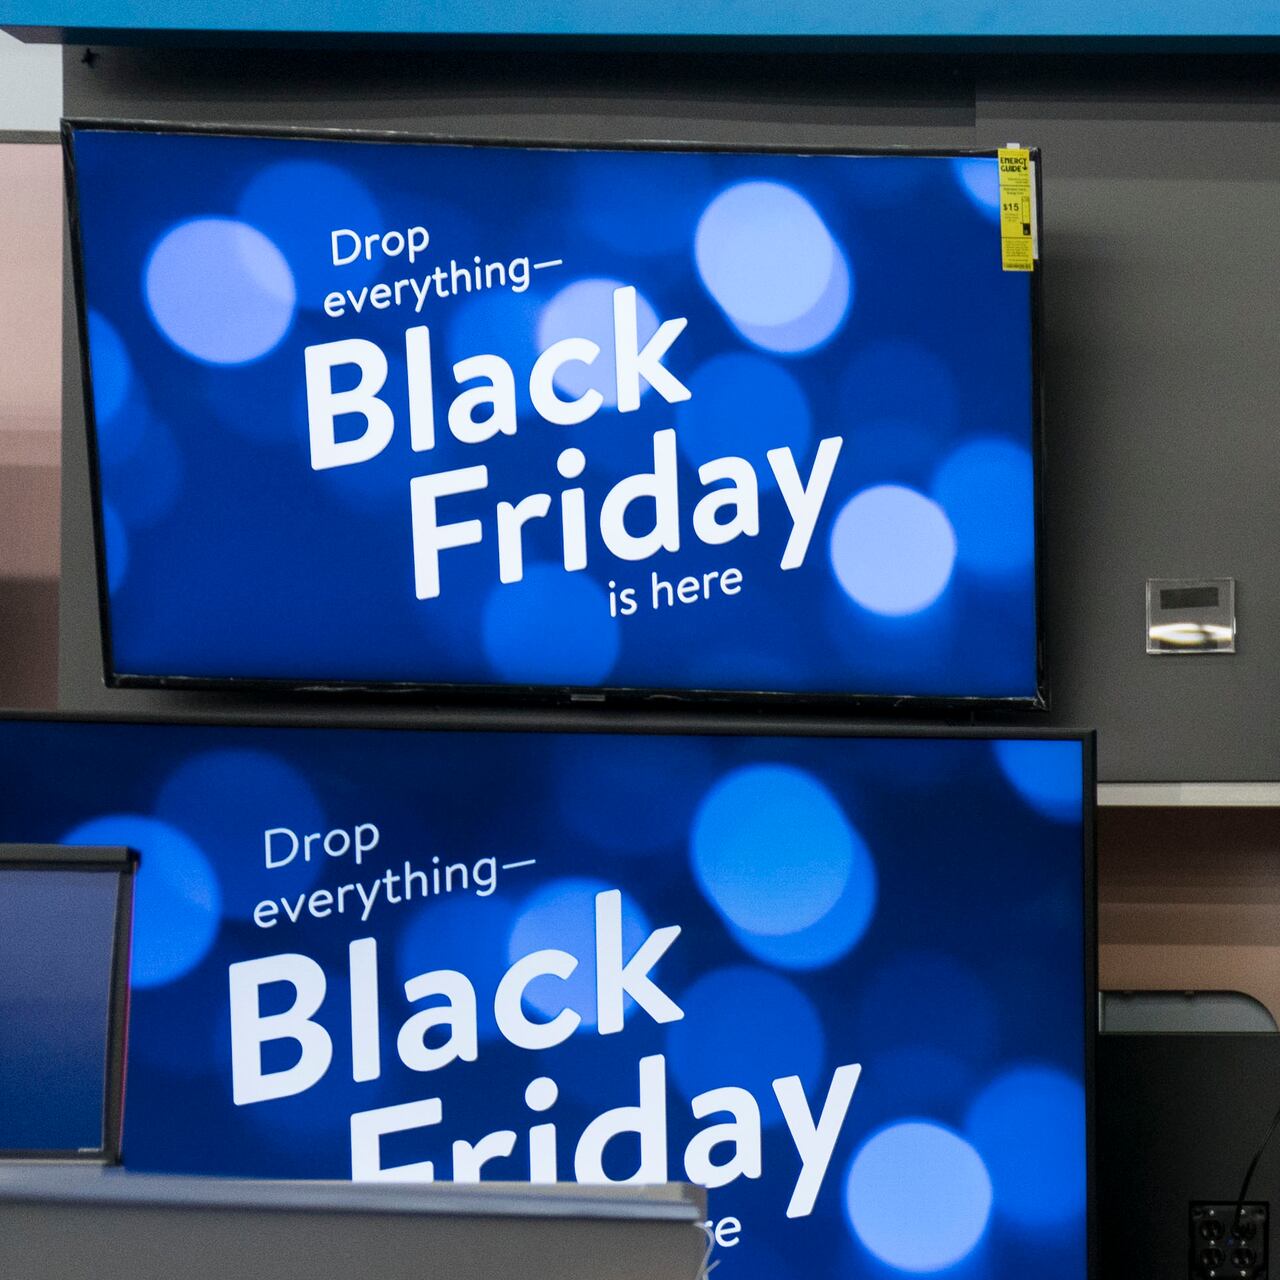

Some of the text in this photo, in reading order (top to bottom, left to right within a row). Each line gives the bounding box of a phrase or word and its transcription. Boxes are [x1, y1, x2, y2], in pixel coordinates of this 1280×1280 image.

[331, 226, 429, 266] Drop
[304, 286, 692, 470] Black
[410, 428, 843, 600] Friday
[609, 568, 743, 617] is here
[264, 823, 381, 869] Drop
[229, 890, 684, 1105] Black
